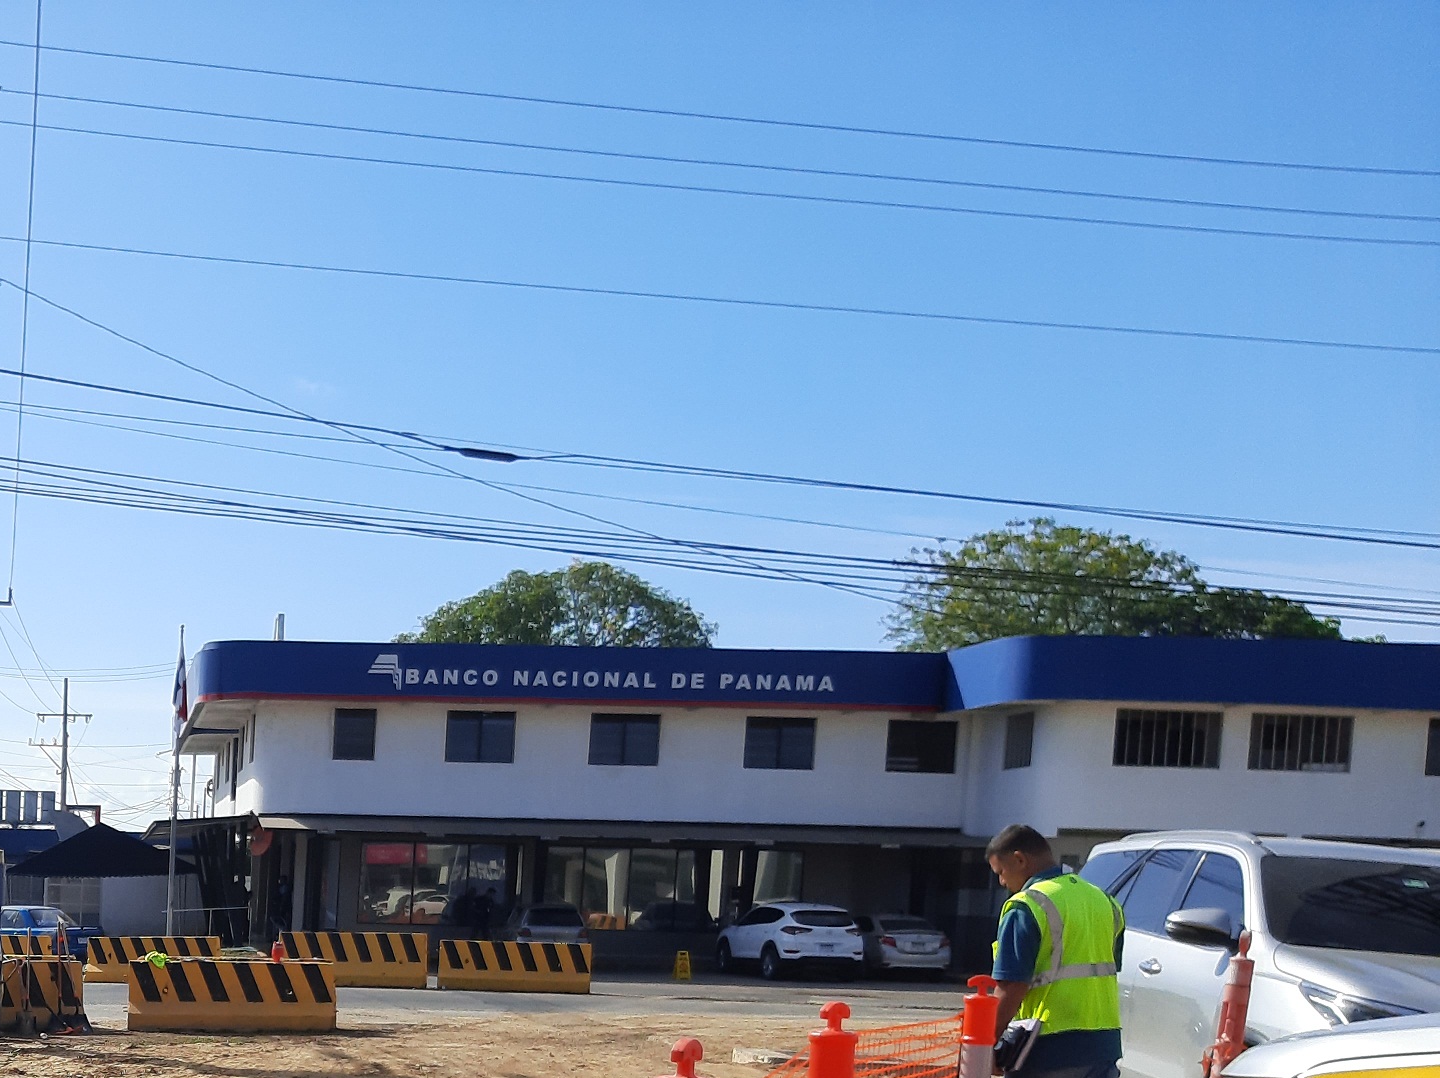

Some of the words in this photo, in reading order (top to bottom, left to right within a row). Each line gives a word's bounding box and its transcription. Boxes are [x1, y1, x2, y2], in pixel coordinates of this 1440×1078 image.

[405, 668, 498, 686] BANCO
[513, 669, 656, 689] NACIONAL
[671, 672, 705, 689] DE
[719, 673, 834, 692] PANAMA
